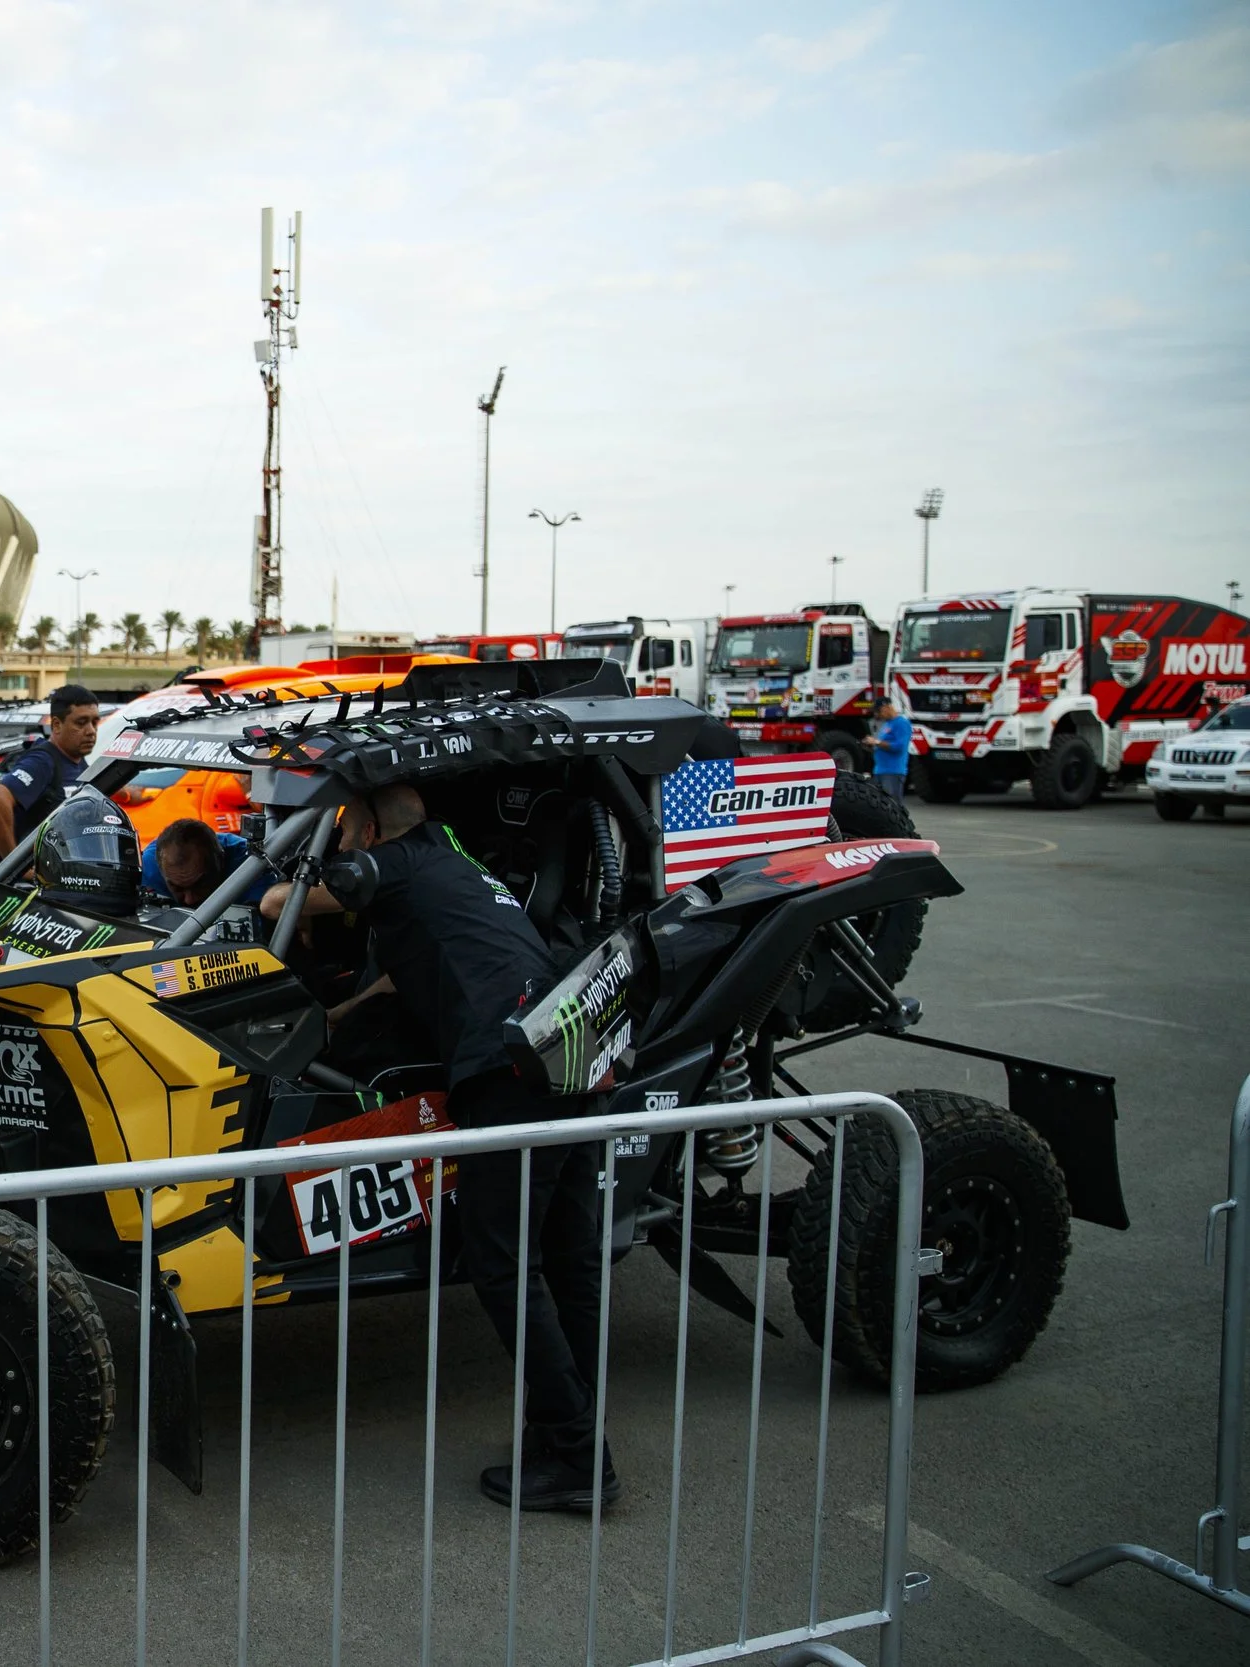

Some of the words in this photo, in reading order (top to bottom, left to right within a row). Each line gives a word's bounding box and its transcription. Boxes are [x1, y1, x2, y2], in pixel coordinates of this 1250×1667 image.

[1163, 643, 1247, 675] MOTUL
[506, 790, 530, 806] OMP
[709, 784, 815, 814] can-am
[60, 876, 101, 887] MONSTER
[8, 911, 83, 951] MONSTER
[2, 935, 52, 959] ENERGY
[184, 958, 198, 974] C.
[199, 951, 241, 971] CURRIE
[187, 975, 201, 991] S.
[202, 962, 261, 988] BERRIMAN
[582, 950, 631, 1018] MONSTER
[596, 987, 628, 1030] ENERGY
[645, 1095, 679, 1112] OMP
[1, 1116, 49, 1131] MAGPUL
[310, 1161, 413, 1244] 405
